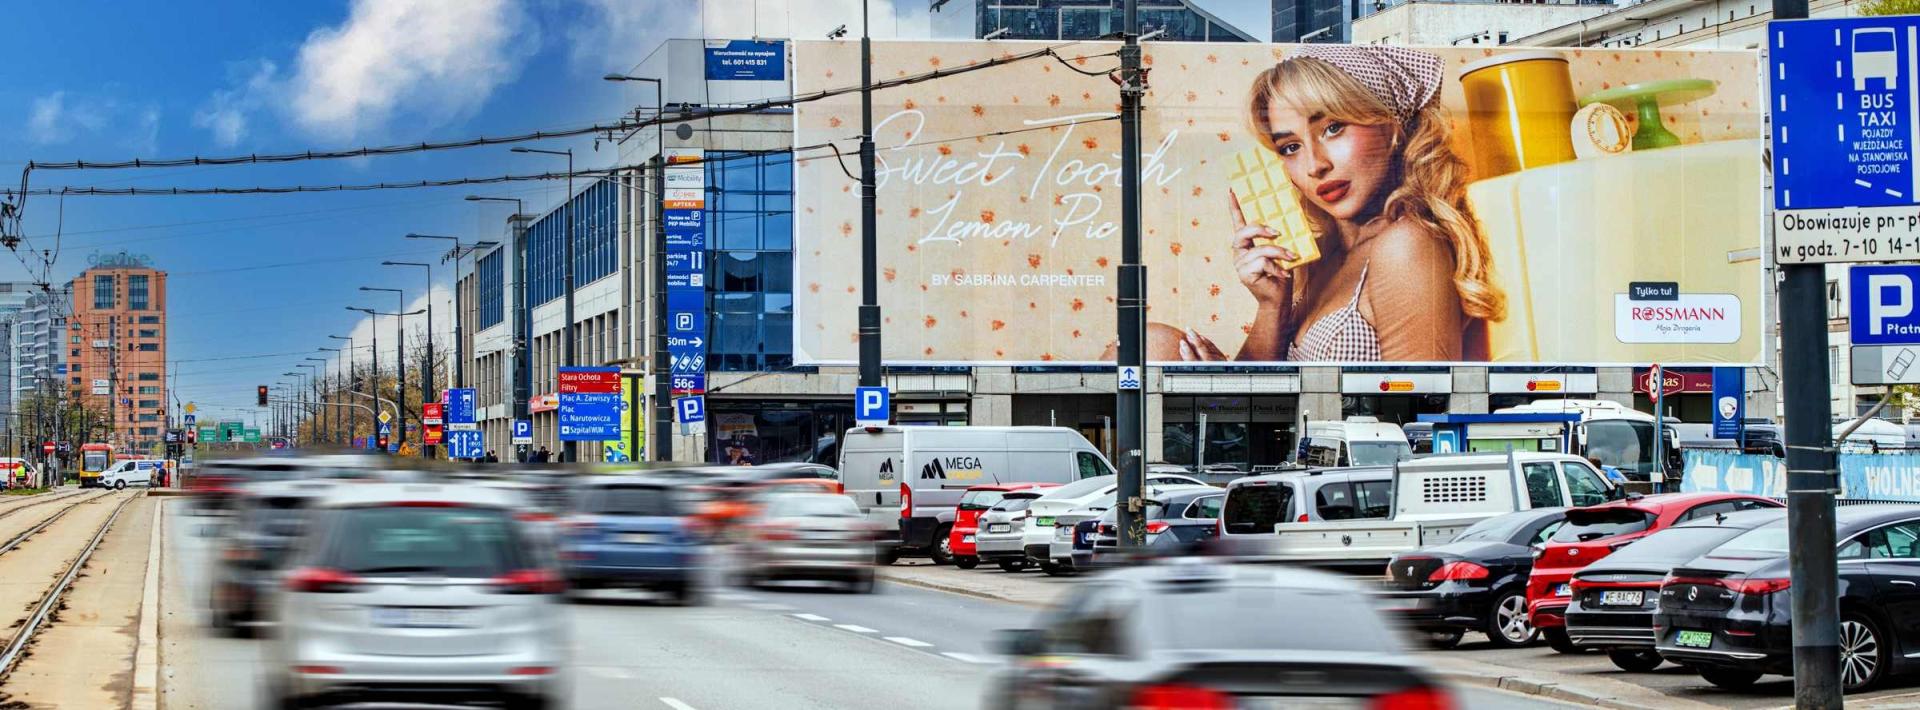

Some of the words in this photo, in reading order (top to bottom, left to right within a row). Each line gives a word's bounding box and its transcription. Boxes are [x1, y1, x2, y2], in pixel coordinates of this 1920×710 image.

[1861, 93, 1894, 109] BUS
[1857, 111, 1896, 127] TAXI
[1862, 128, 1893, 138] POJAZDY
[852, 109, 1025, 199] Sweet
[1848, 153, 1859, 163] NA
[1862, 151, 1908, 162] STANOWISKA
[1857, 164, 1900, 174] POSTOJOWE
[918, 190, 1041, 246] Lemon
[1052, 193, 1118, 248] Pie
[1783, 212, 1871, 234] Obowiązuje
[1780, 245, 1791, 257] w
[1797, 240, 1838, 261] godz.
[1843, 238, 1877, 255] 7-10
[666, 253, 687, 261] parking
[932, 275, 949, 286] BY
[955, 275, 1017, 286] SABRINA
[1020, 275, 1105, 286] CARPENTER
[1635, 287, 1659, 297] Tylko
[1660, 287, 1673, 296] tu!
[1868, 273, 1913, 335] P
[1632, 306, 1724, 321] ROSSMANN
[561, 373, 578, 381] Stara
[578, 373, 601, 381] Ochota
[561, 384, 578, 392] Filtry
[674, 379, 695, 389] 56c
[584, 395, 610, 403] Zawiszy
[863, 391, 882, 416] P
[561, 405, 575, 413] Plac
[684, 400, 698, 420] P
[570, 414, 611, 422] Narutowicza
[517, 422, 528, 436] P
[570, 426, 590, 435] Szpital
[945, 457, 982, 470] MEGA
[879, 473, 894, 481] MEGA
